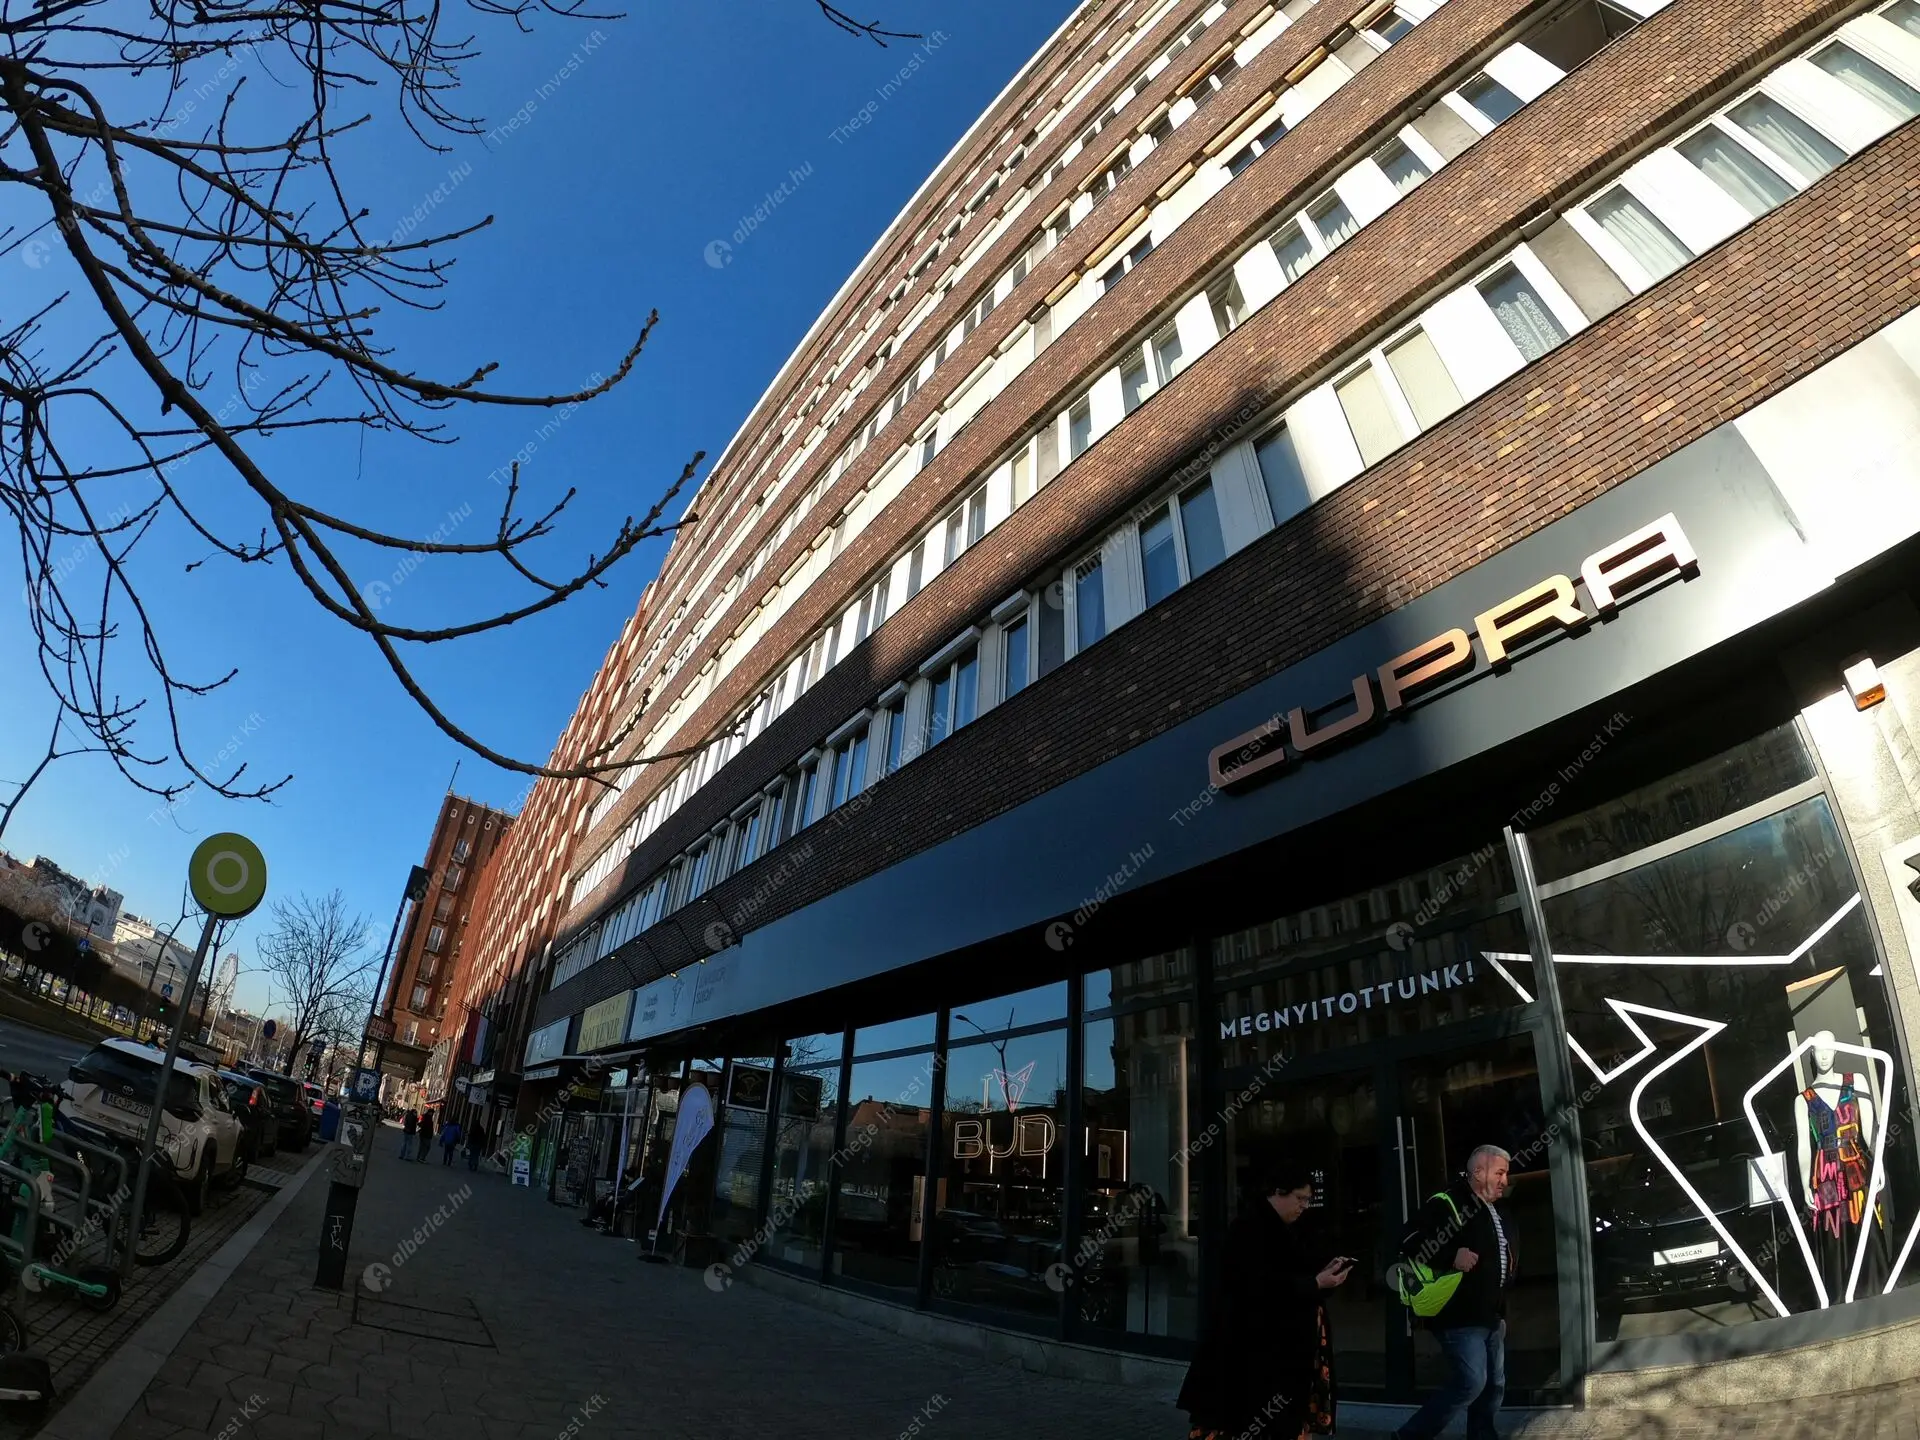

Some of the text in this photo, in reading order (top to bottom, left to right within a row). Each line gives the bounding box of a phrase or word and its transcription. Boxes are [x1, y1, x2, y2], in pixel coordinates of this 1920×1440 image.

[1208, 512, 1698, 789] CUPRA
[1220, 960, 1474, 1039] MEGNYITOTTUNK!
[954, 1113, 1056, 1159] BUD
[1670, 1249, 1703, 1259] TAVASCAN
